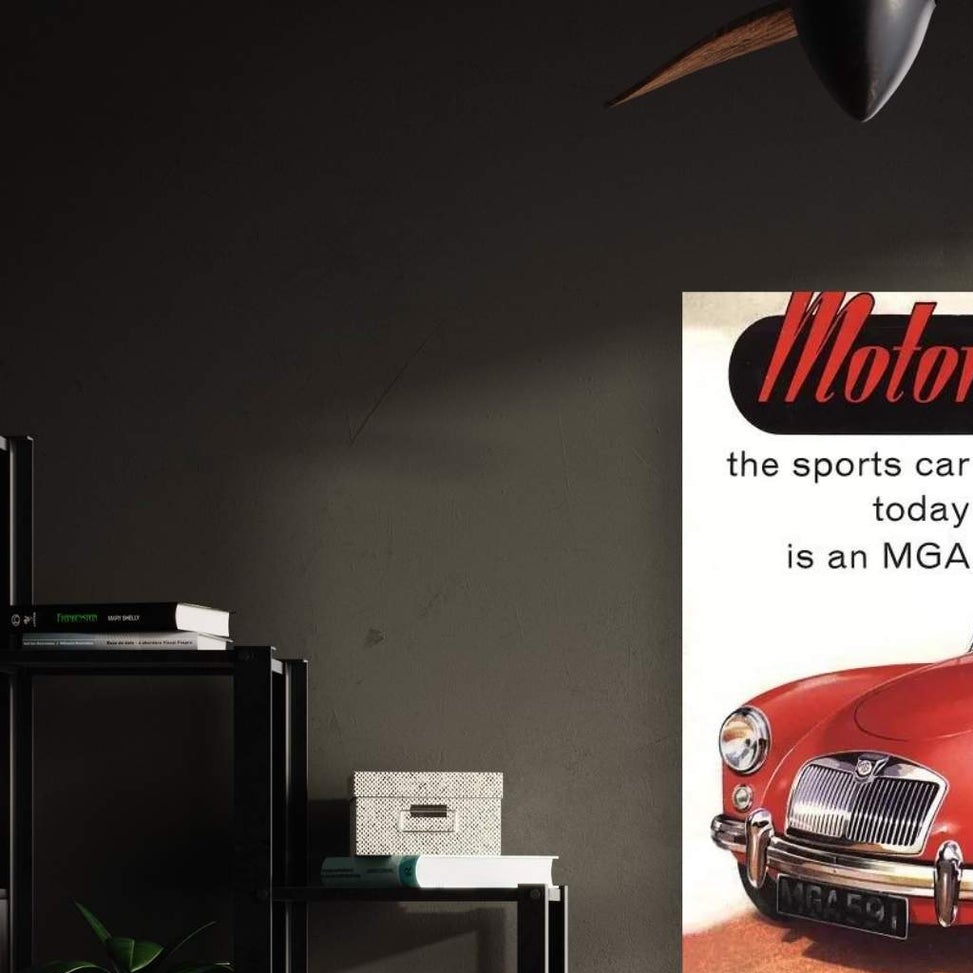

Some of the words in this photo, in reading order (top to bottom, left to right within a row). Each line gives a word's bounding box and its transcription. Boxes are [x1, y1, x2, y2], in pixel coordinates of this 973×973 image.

[727, 450, 779, 477] the
[793, 451, 901, 483] sports
[916, 457, 970, 477] car
[873, 494, 969, 528] today
[788, 543, 814, 569] is
[828, 550, 867, 569] an
[884, 542, 970, 569] MGA
